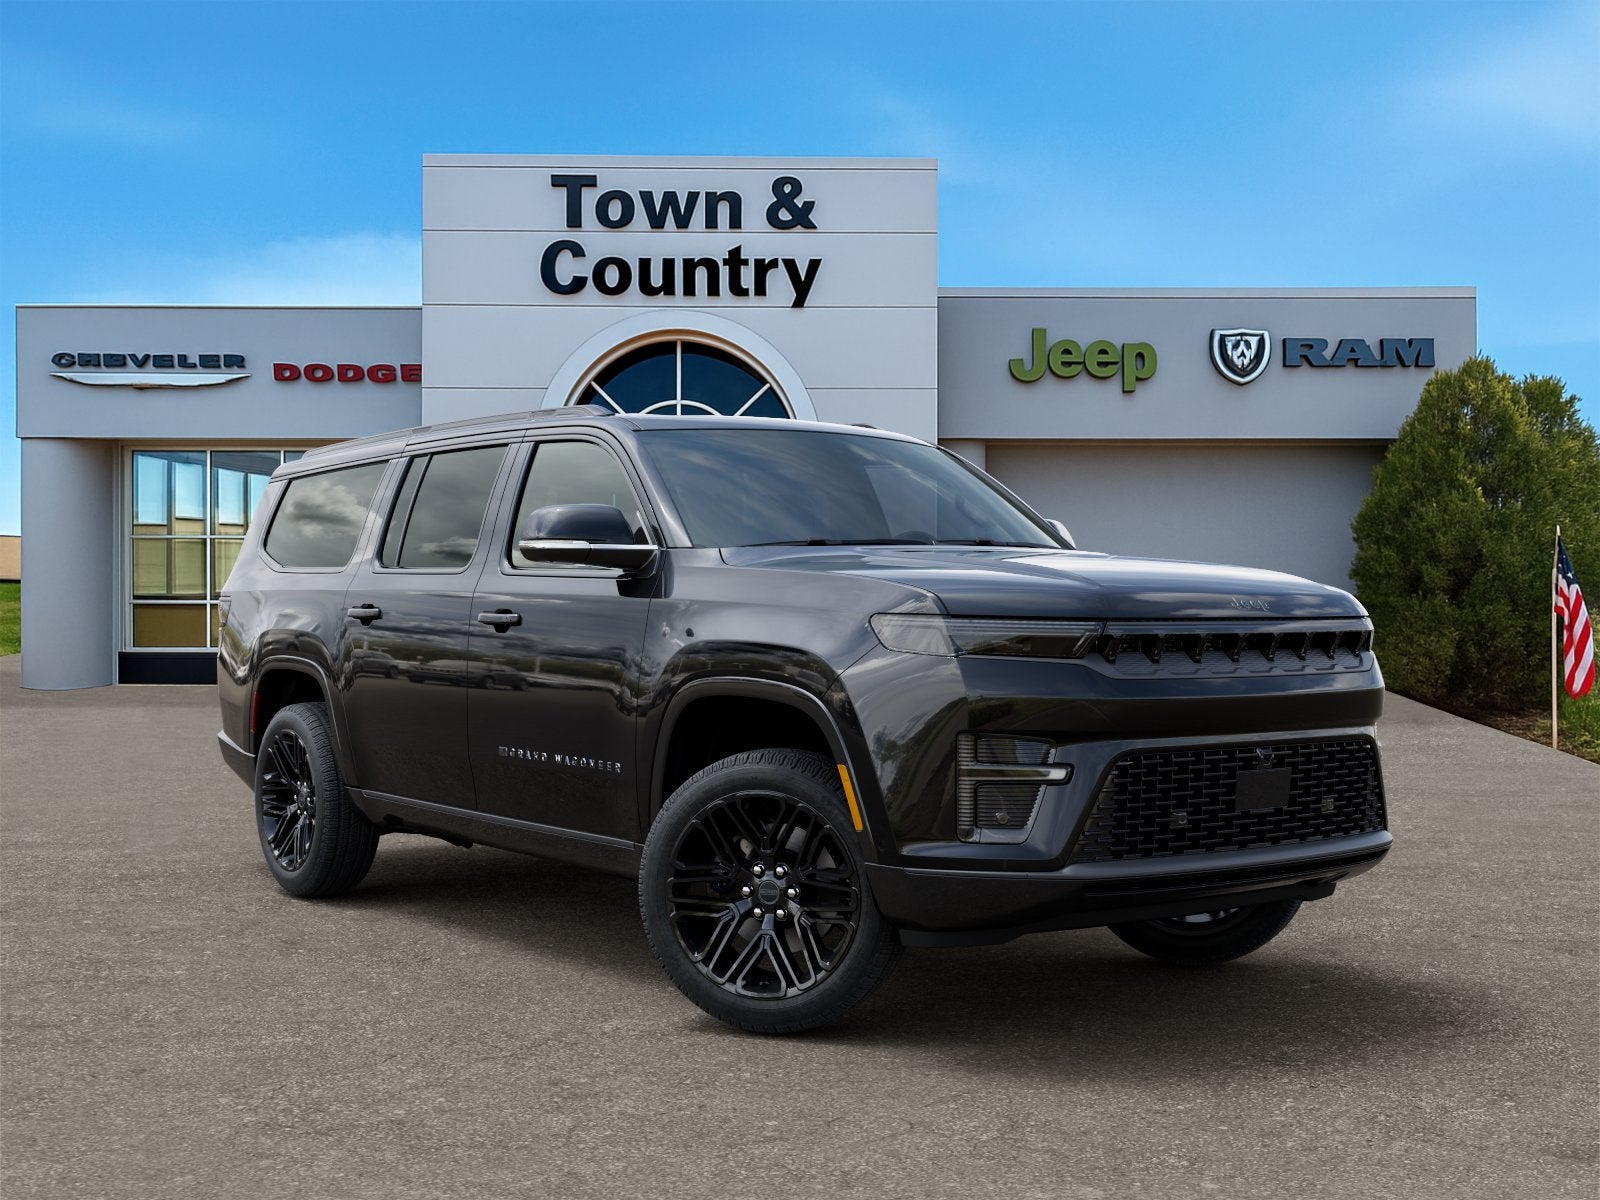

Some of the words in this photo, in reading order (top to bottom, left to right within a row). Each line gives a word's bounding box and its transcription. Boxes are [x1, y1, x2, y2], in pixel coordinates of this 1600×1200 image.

[550, 174, 742, 229] Town
[765, 176, 818, 230] &
[540, 239, 822, 308] Country
[1008, 328, 1157, 393] Jeep
[1283, 338, 1435, 368] RAM
[509, 747, 548, 761] GRAND
[554, 754, 621, 772] WAGONEER
